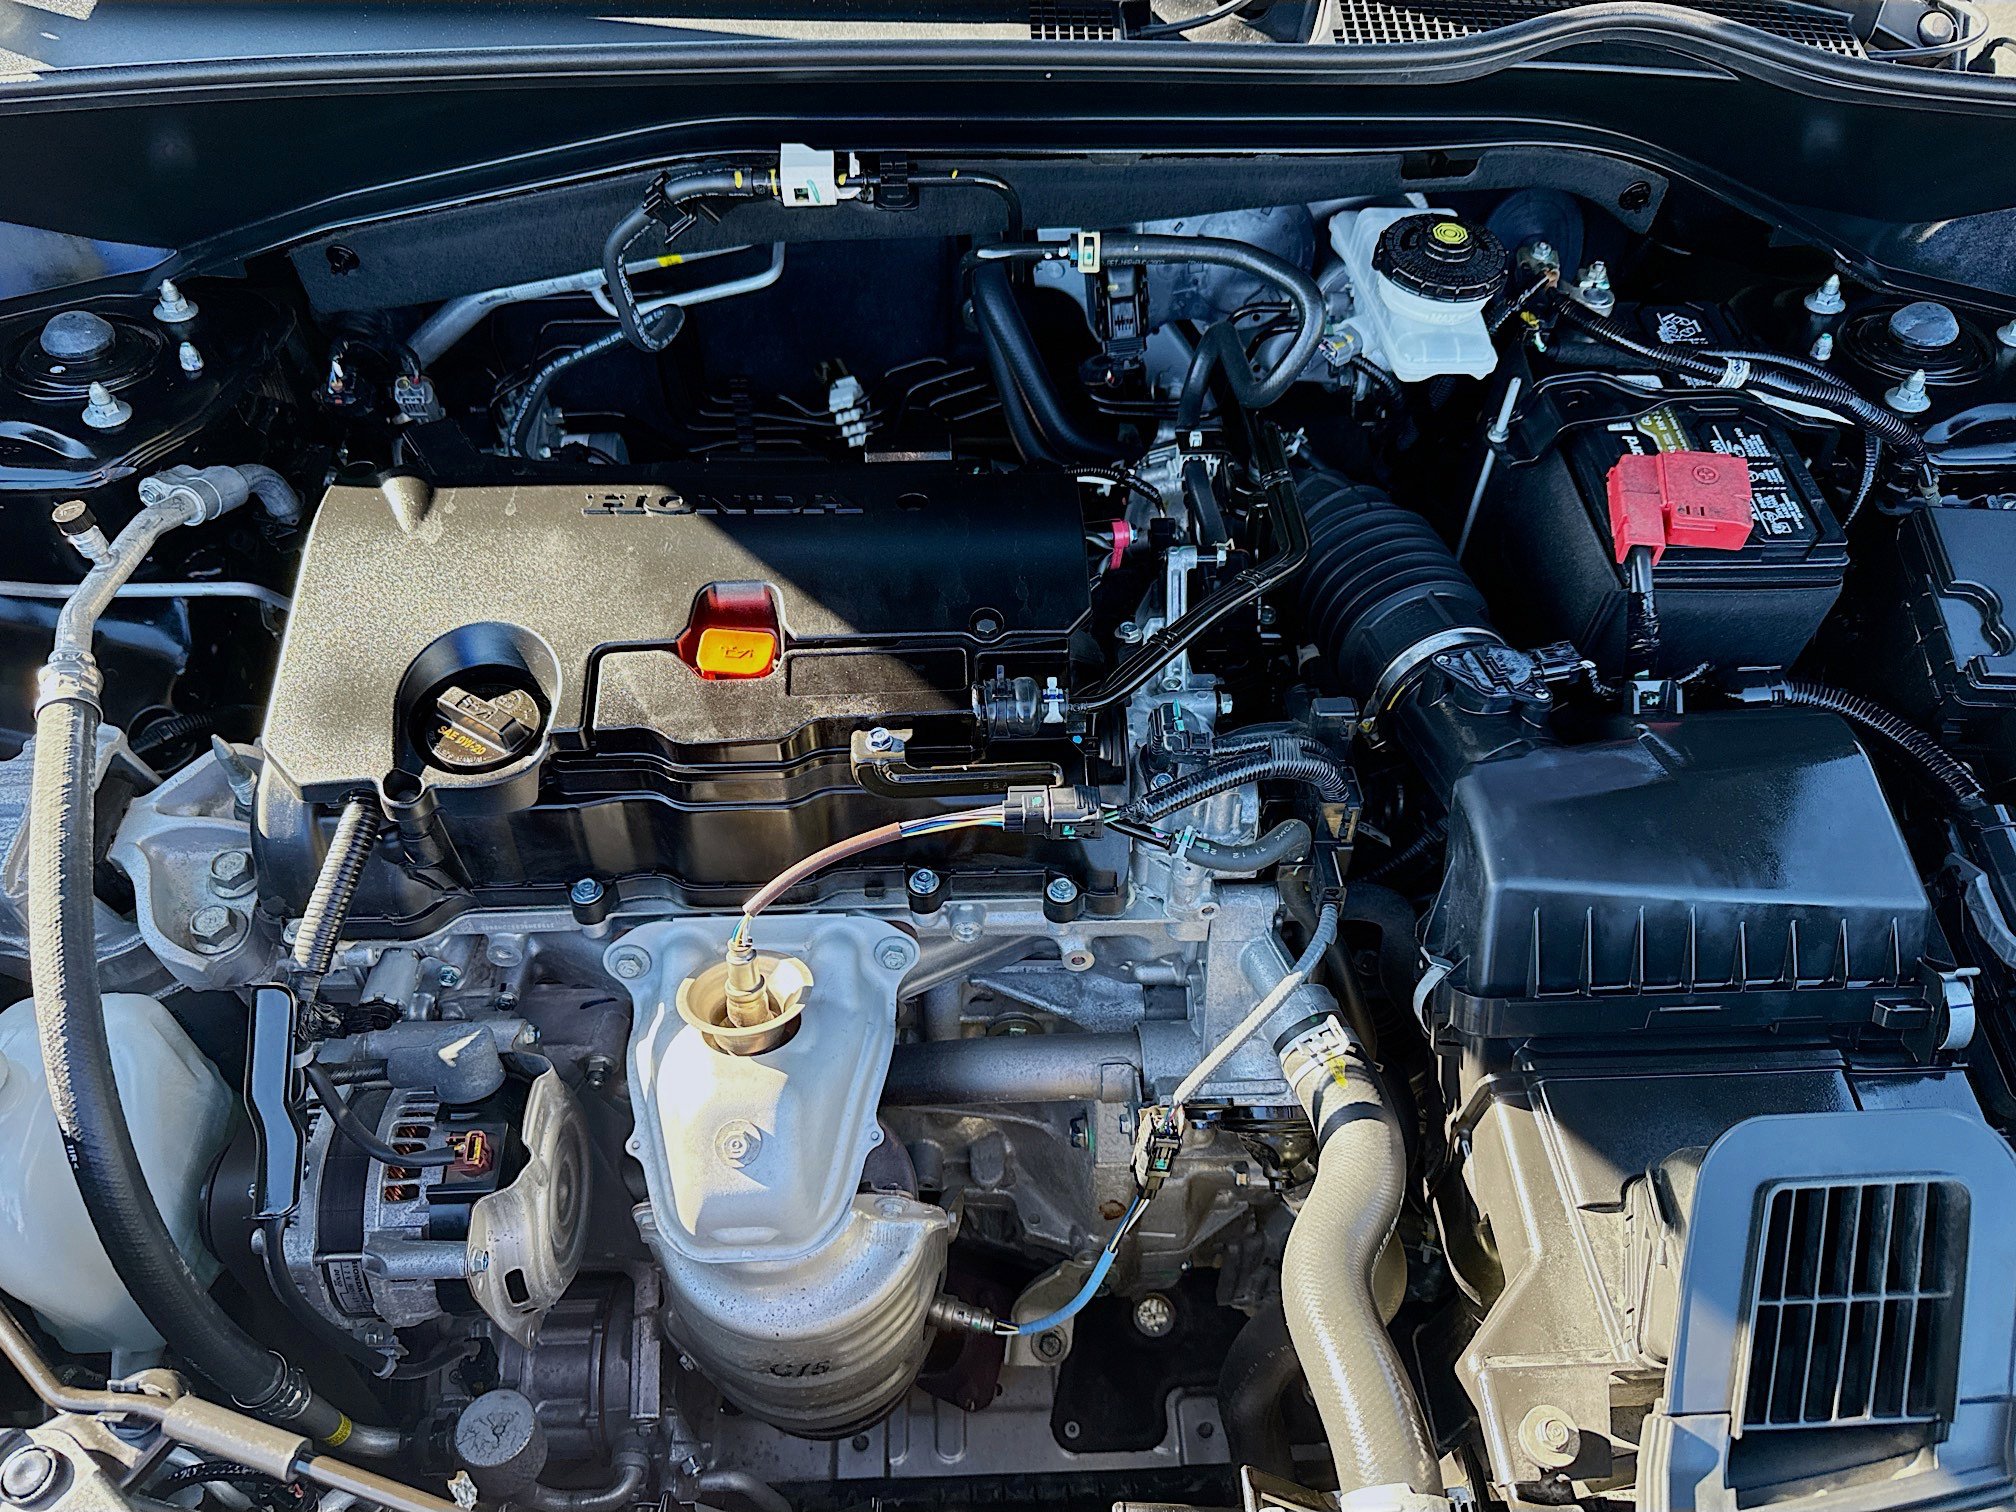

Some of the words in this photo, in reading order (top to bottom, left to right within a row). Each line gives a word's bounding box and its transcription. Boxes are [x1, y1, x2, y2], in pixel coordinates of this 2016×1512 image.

[581, 492, 864, 516] HONDA
[438, 725, 459, 741] SAE
[455, 735, 487, 756] 0W-20
